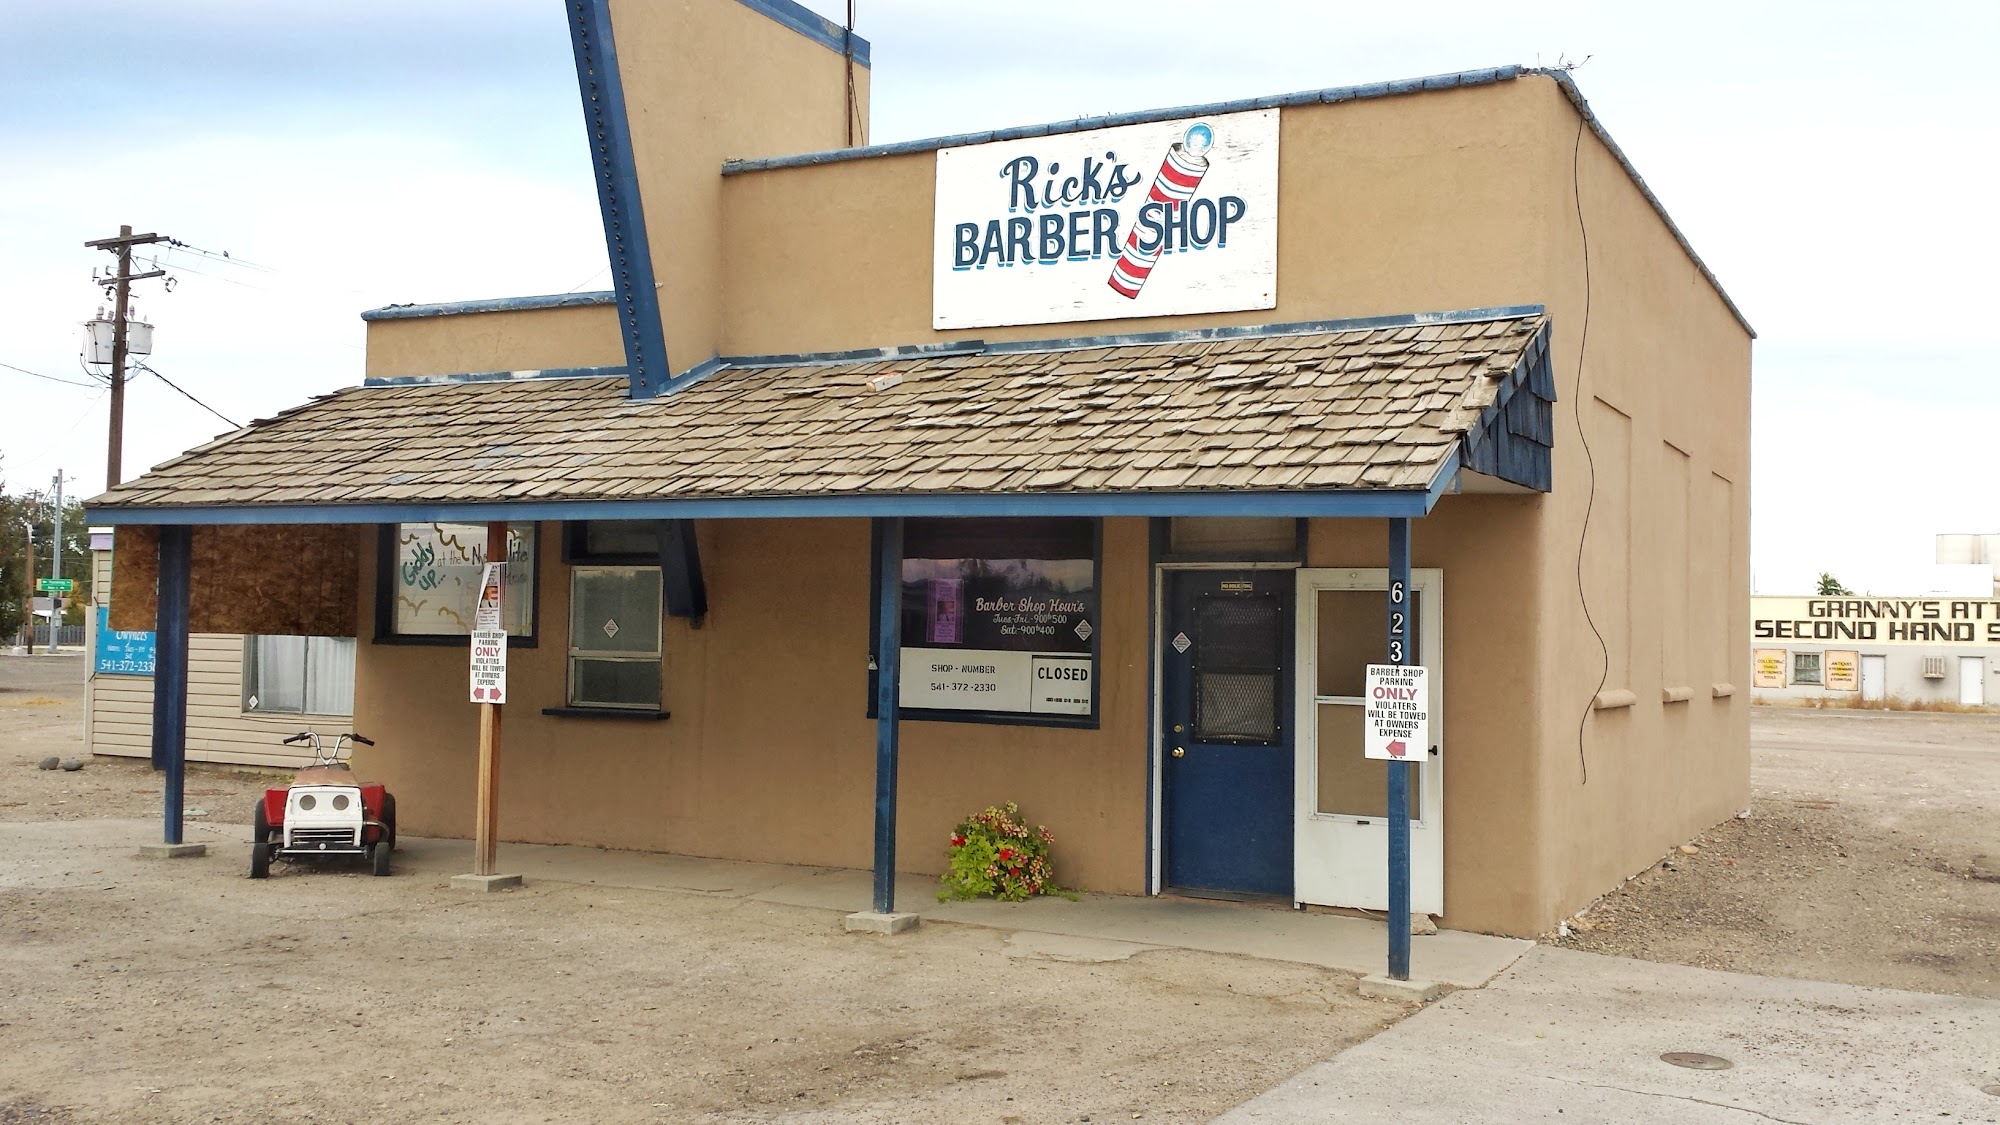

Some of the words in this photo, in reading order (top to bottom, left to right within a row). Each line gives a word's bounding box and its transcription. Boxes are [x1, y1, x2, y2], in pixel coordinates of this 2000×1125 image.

[999, 151, 1143, 213] Rick's
[952, 208, 1123, 271] BARBER
[1137, 196, 1248, 255] SHOP
[975, 597, 1016, 612] Barber
[1018, 596, 1046, 615] Shop
[1808, 600, 1940, 619] GRANNY'S
[1755, 619, 1877, 640] SECOND
[1888, 621, 1975, 641] HAND
[475, 647, 501, 657] ONLY
[931, 664, 953, 673] SHOP
[962, 665, 996, 674] NUMBER
[1038, 667, 1088, 681] CLOSED
[1370, 668, 1400, 676] BARBER
[1403, 669, 1424, 677] SHOP
[1380, 677, 1414, 686] PARKING
[1373, 686, 1418, 700] ONLY
[1375, 701, 1417, 710] VIOLATERS
[1368, 710, 1385, 718] WILL
[1388, 711, 1397, 719] BE
[1400, 711, 1426, 720] TOWED
[1386, 720, 1419, 729] OWNERS
[1380, 728, 1412, 738] EXPENSE
